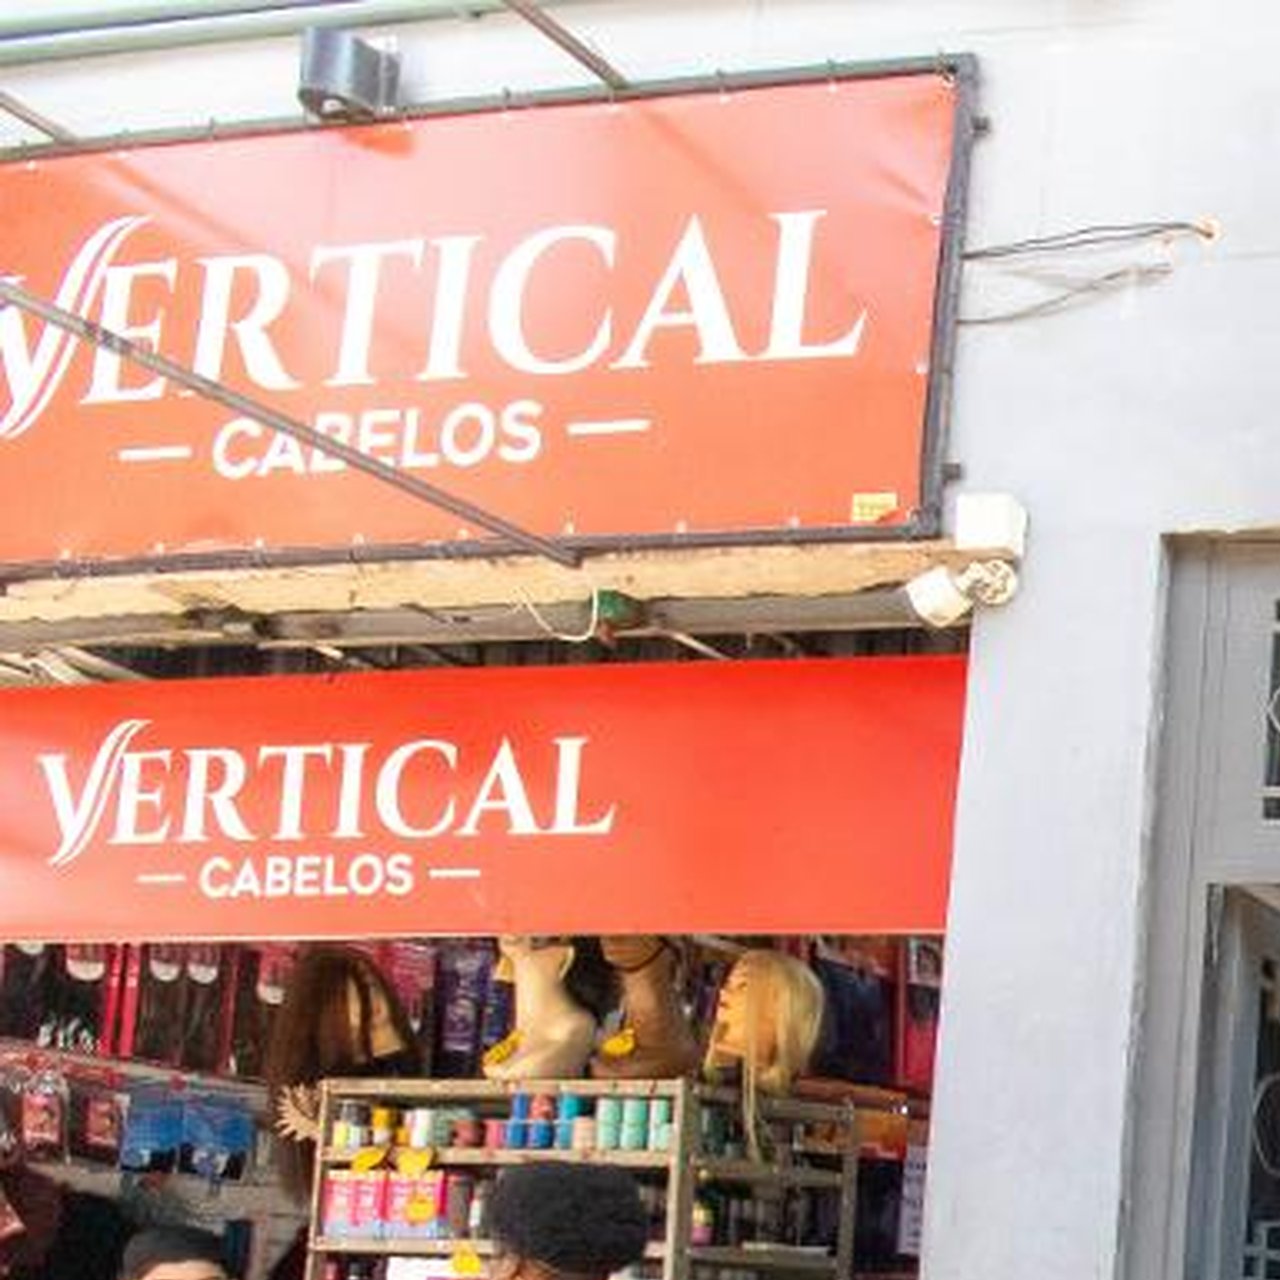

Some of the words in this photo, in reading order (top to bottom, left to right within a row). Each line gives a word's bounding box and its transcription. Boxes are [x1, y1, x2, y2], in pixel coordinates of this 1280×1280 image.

[0, 209, 868, 440] VERTICAL
[211, 399, 544, 479] CABELOS
[36, 719, 616, 867] VERTICAL
[199, 854, 413, 898] CABELOS
